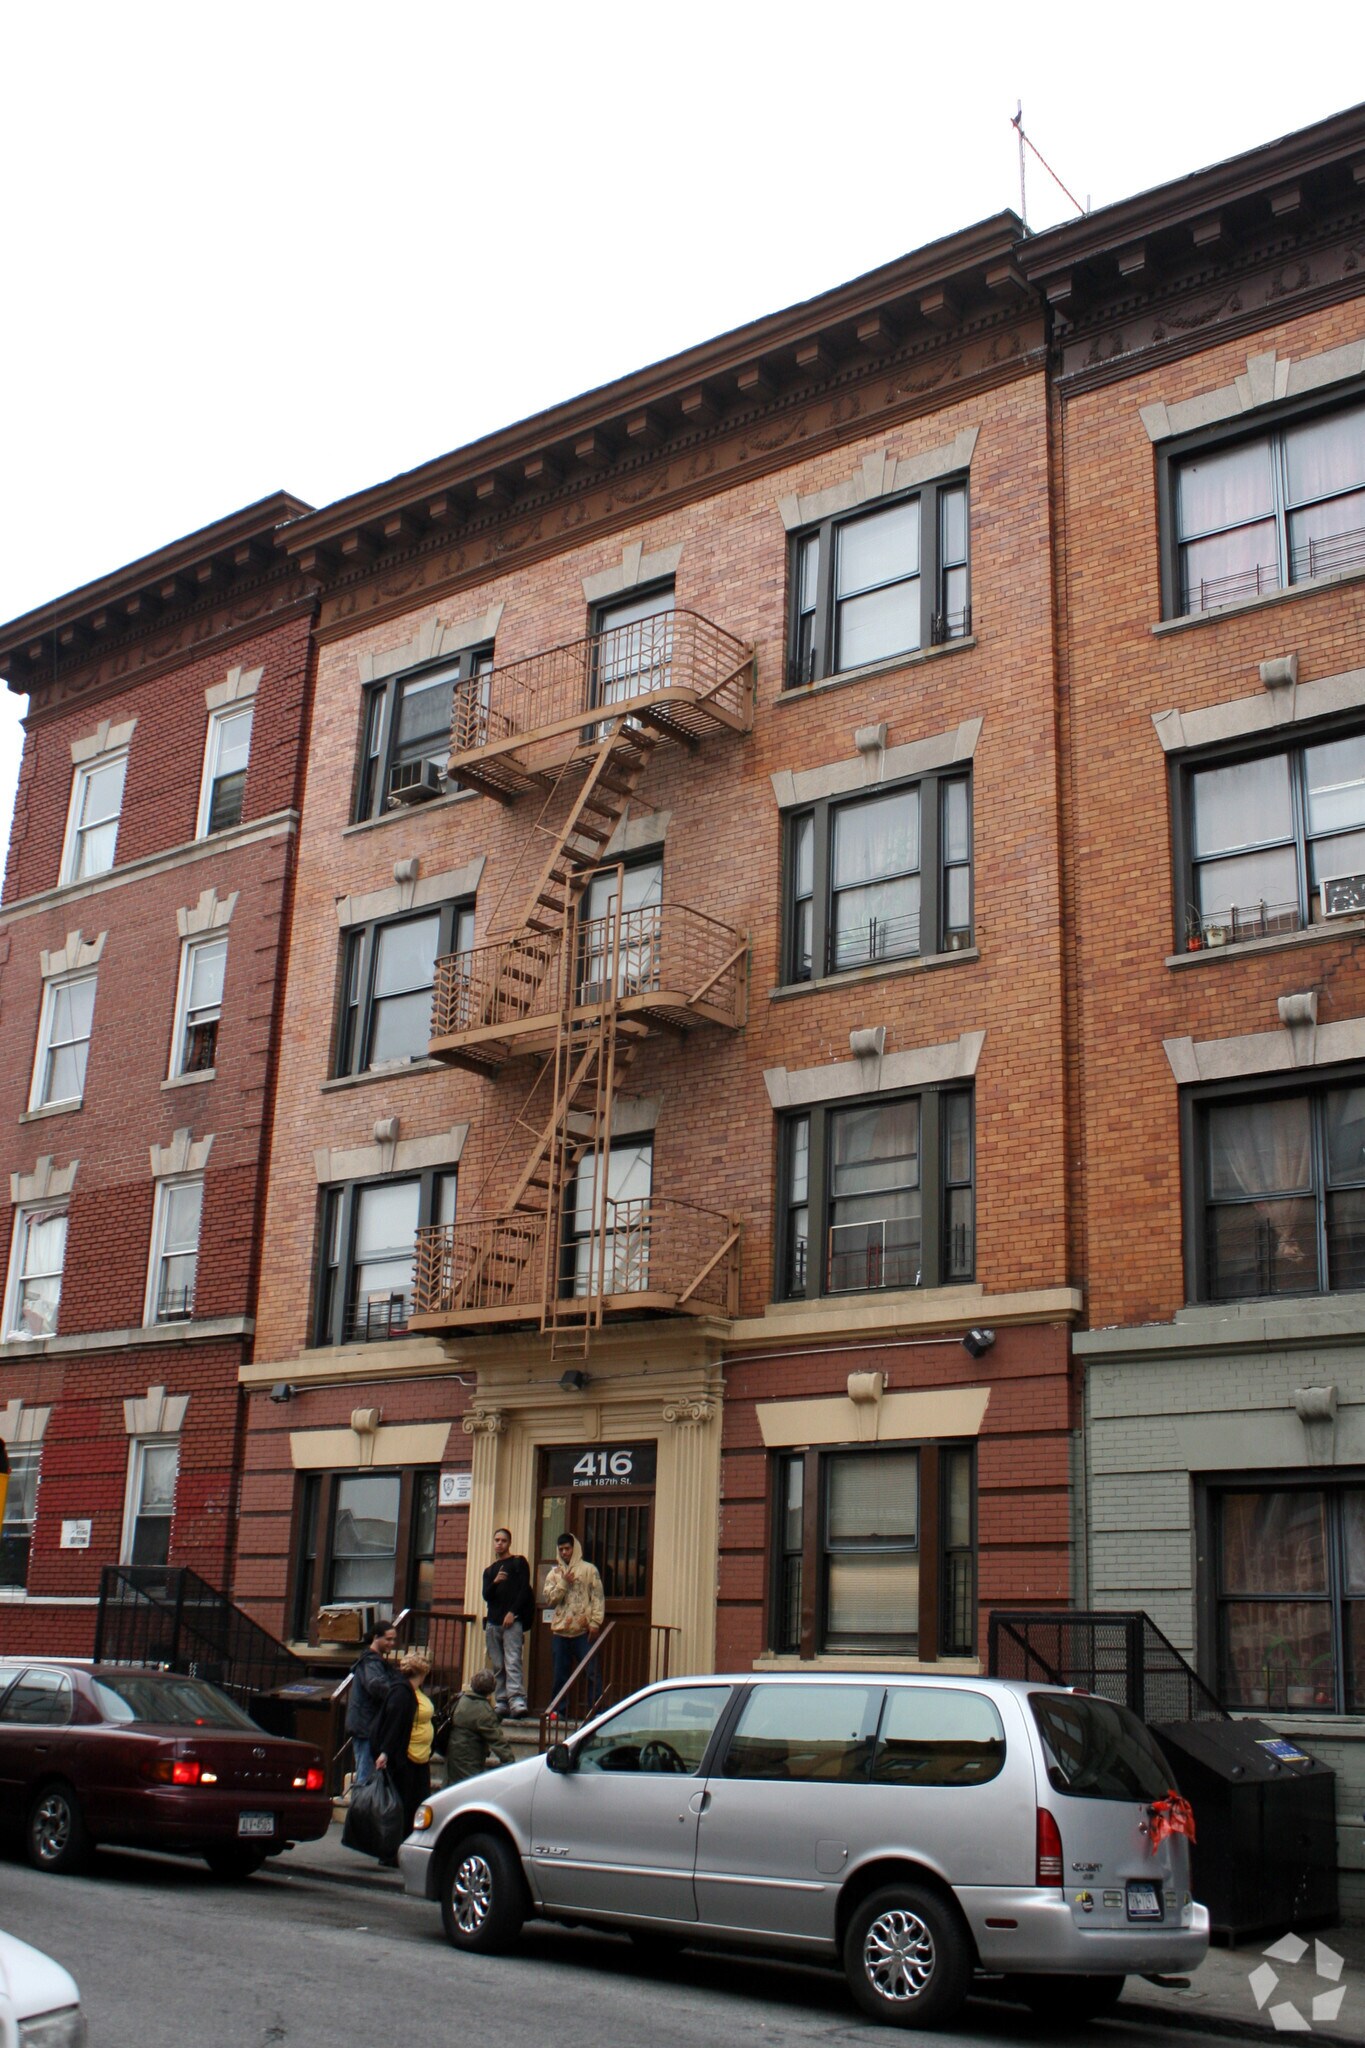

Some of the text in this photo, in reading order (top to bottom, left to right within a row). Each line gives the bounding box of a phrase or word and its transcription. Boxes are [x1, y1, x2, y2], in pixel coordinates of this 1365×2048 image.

[573, 1450, 633, 1476] 416
[572, 1477, 632, 1487] East 187th St.
